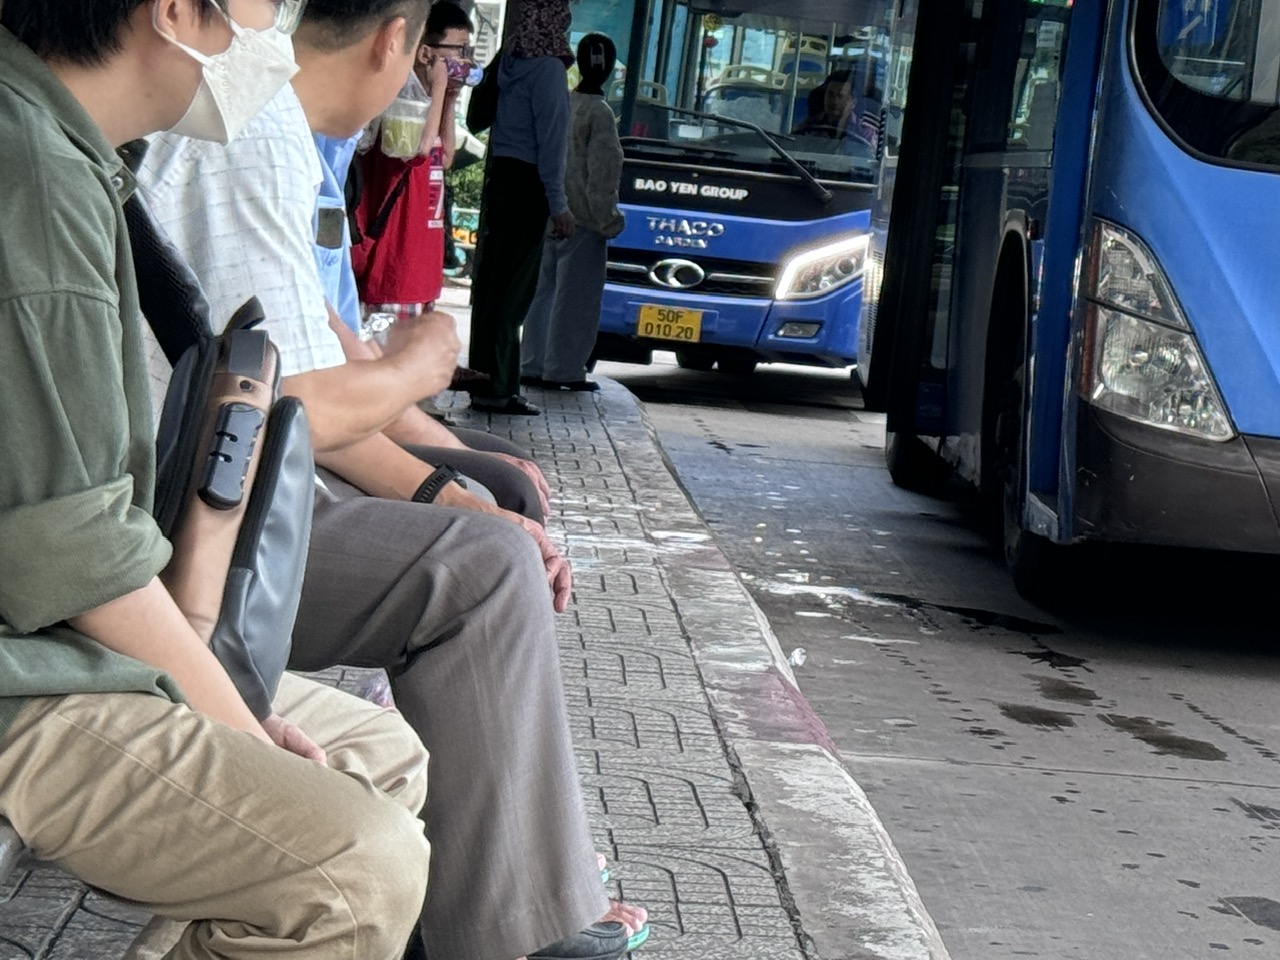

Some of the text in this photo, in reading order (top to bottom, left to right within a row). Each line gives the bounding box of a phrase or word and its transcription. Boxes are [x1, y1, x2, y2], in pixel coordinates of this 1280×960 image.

[634, 178, 749, 201] BAO YEN GROUP
[646, 216, 726, 237] THACO
[657, 308, 685, 324] 50F
